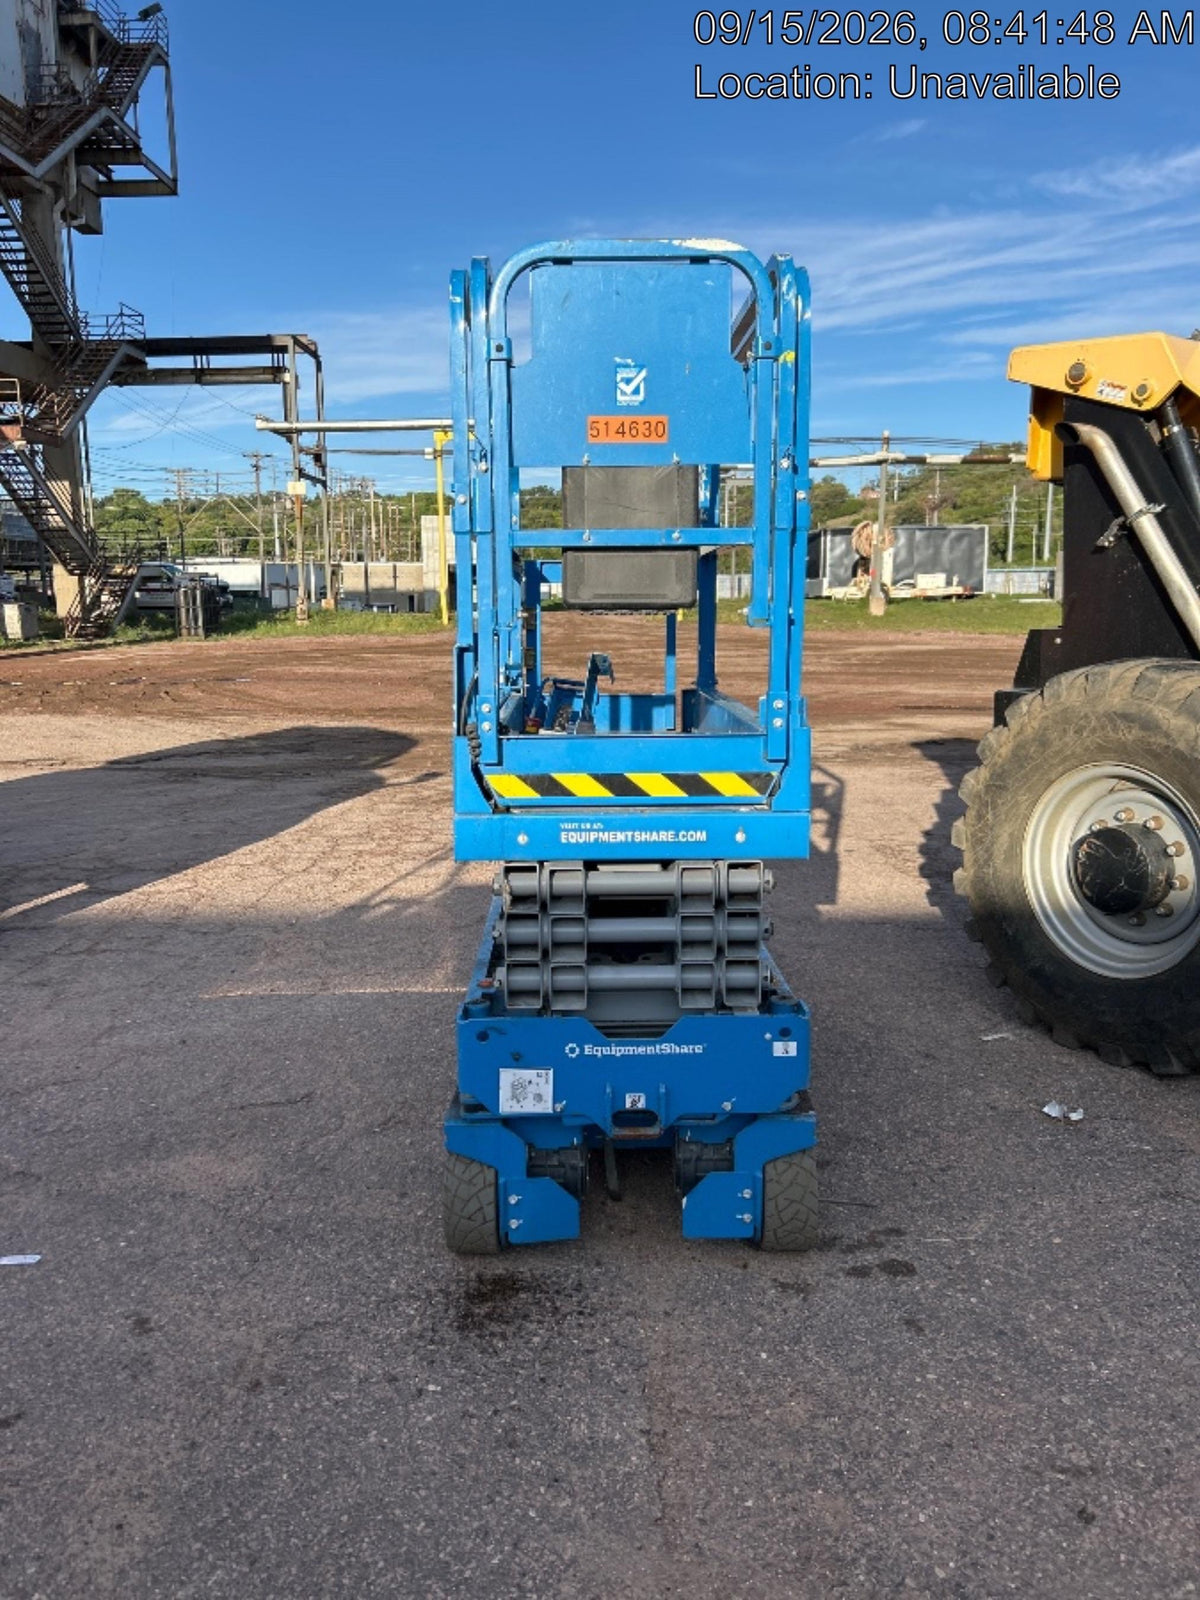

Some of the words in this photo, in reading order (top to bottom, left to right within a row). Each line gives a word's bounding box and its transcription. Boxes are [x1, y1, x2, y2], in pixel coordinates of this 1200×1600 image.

[589, 421, 666, 438] 514630
[561, 831, 706, 843] EQUIPMENTSHARE.COM
[584, 1043, 703, 1057] EquipmentShare
